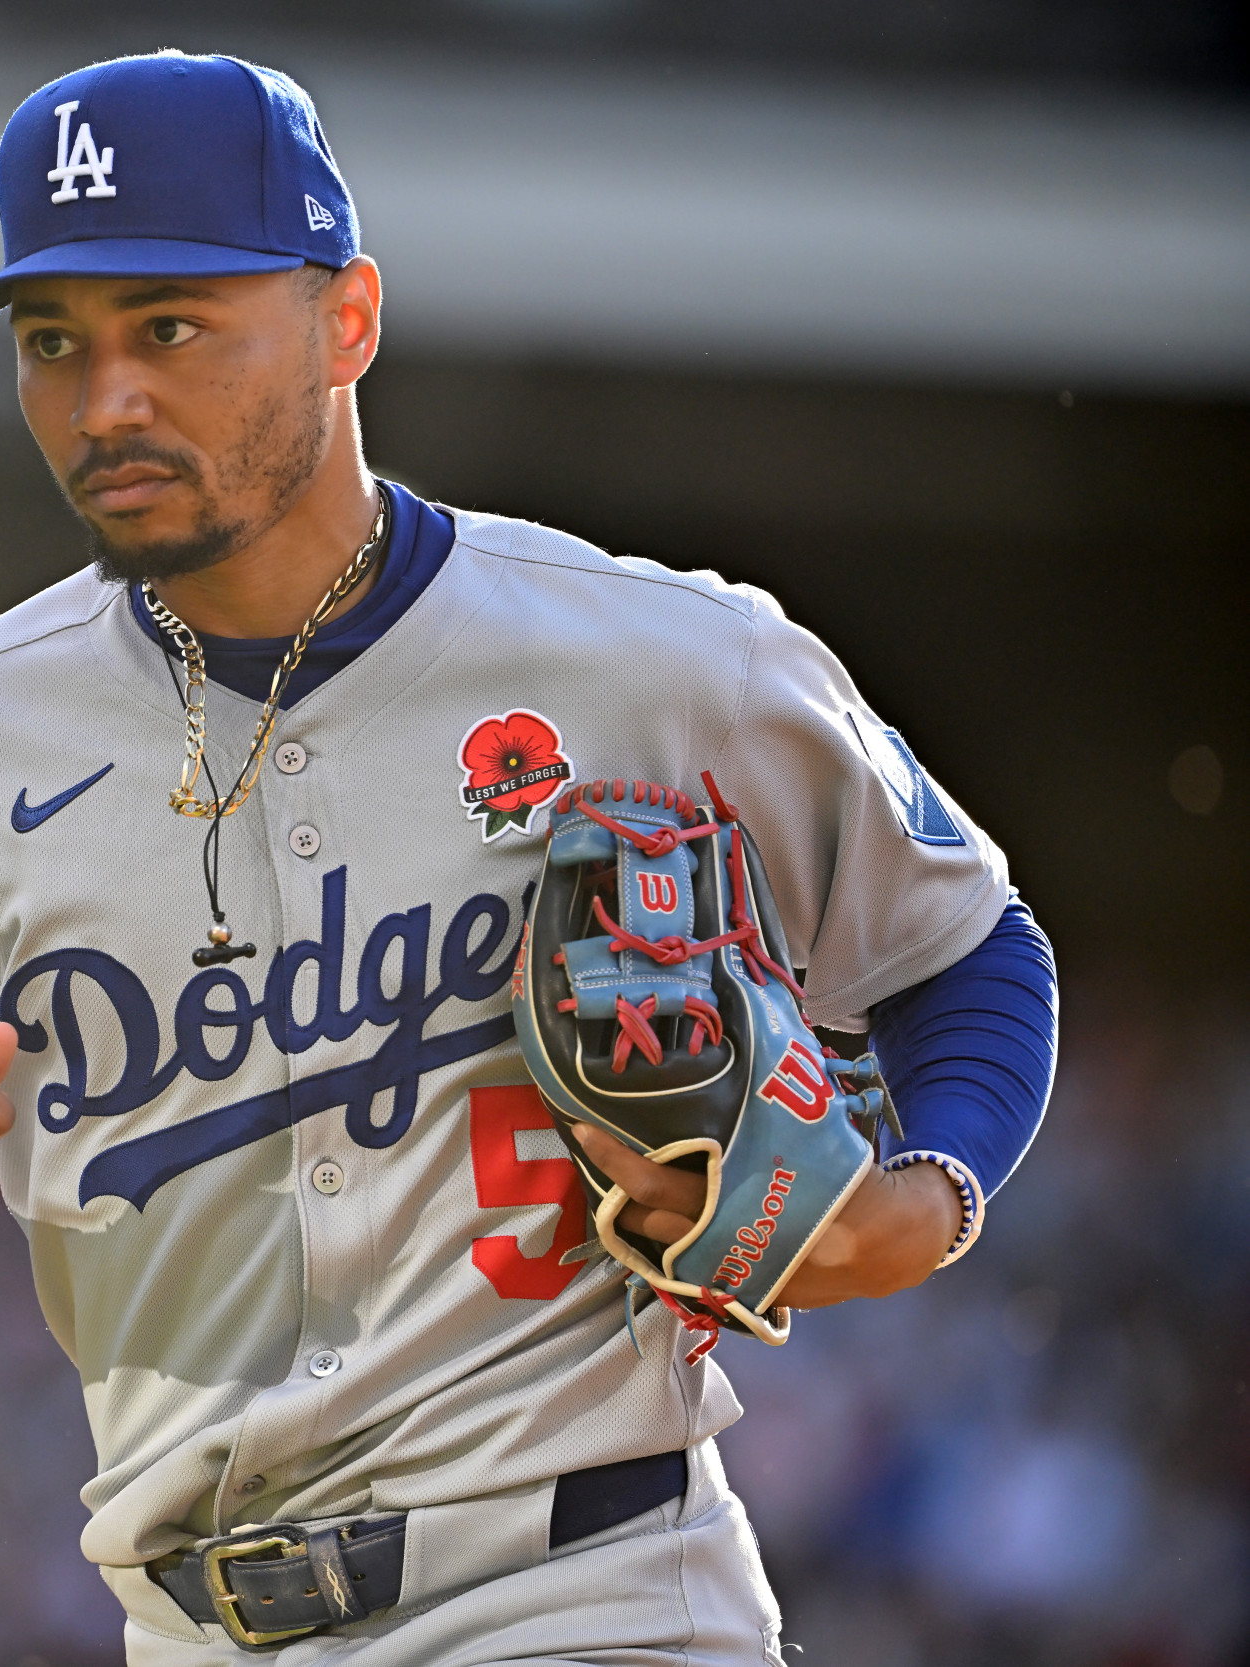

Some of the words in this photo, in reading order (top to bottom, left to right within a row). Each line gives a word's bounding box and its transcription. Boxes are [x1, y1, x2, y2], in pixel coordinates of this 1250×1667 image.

[47, 99, 117, 205] LA
[468, 786, 496, 801] LEST
[500, 779, 517, 793] WE
[521, 765, 563, 786] FORGET
[636, 871, 679, 915] W
[728, 928, 751, 981] BETT
[0, 864, 537, 1149] Dodge
[755, 1037, 836, 1125] W
[713, 1167, 797, 1288] Wilson
